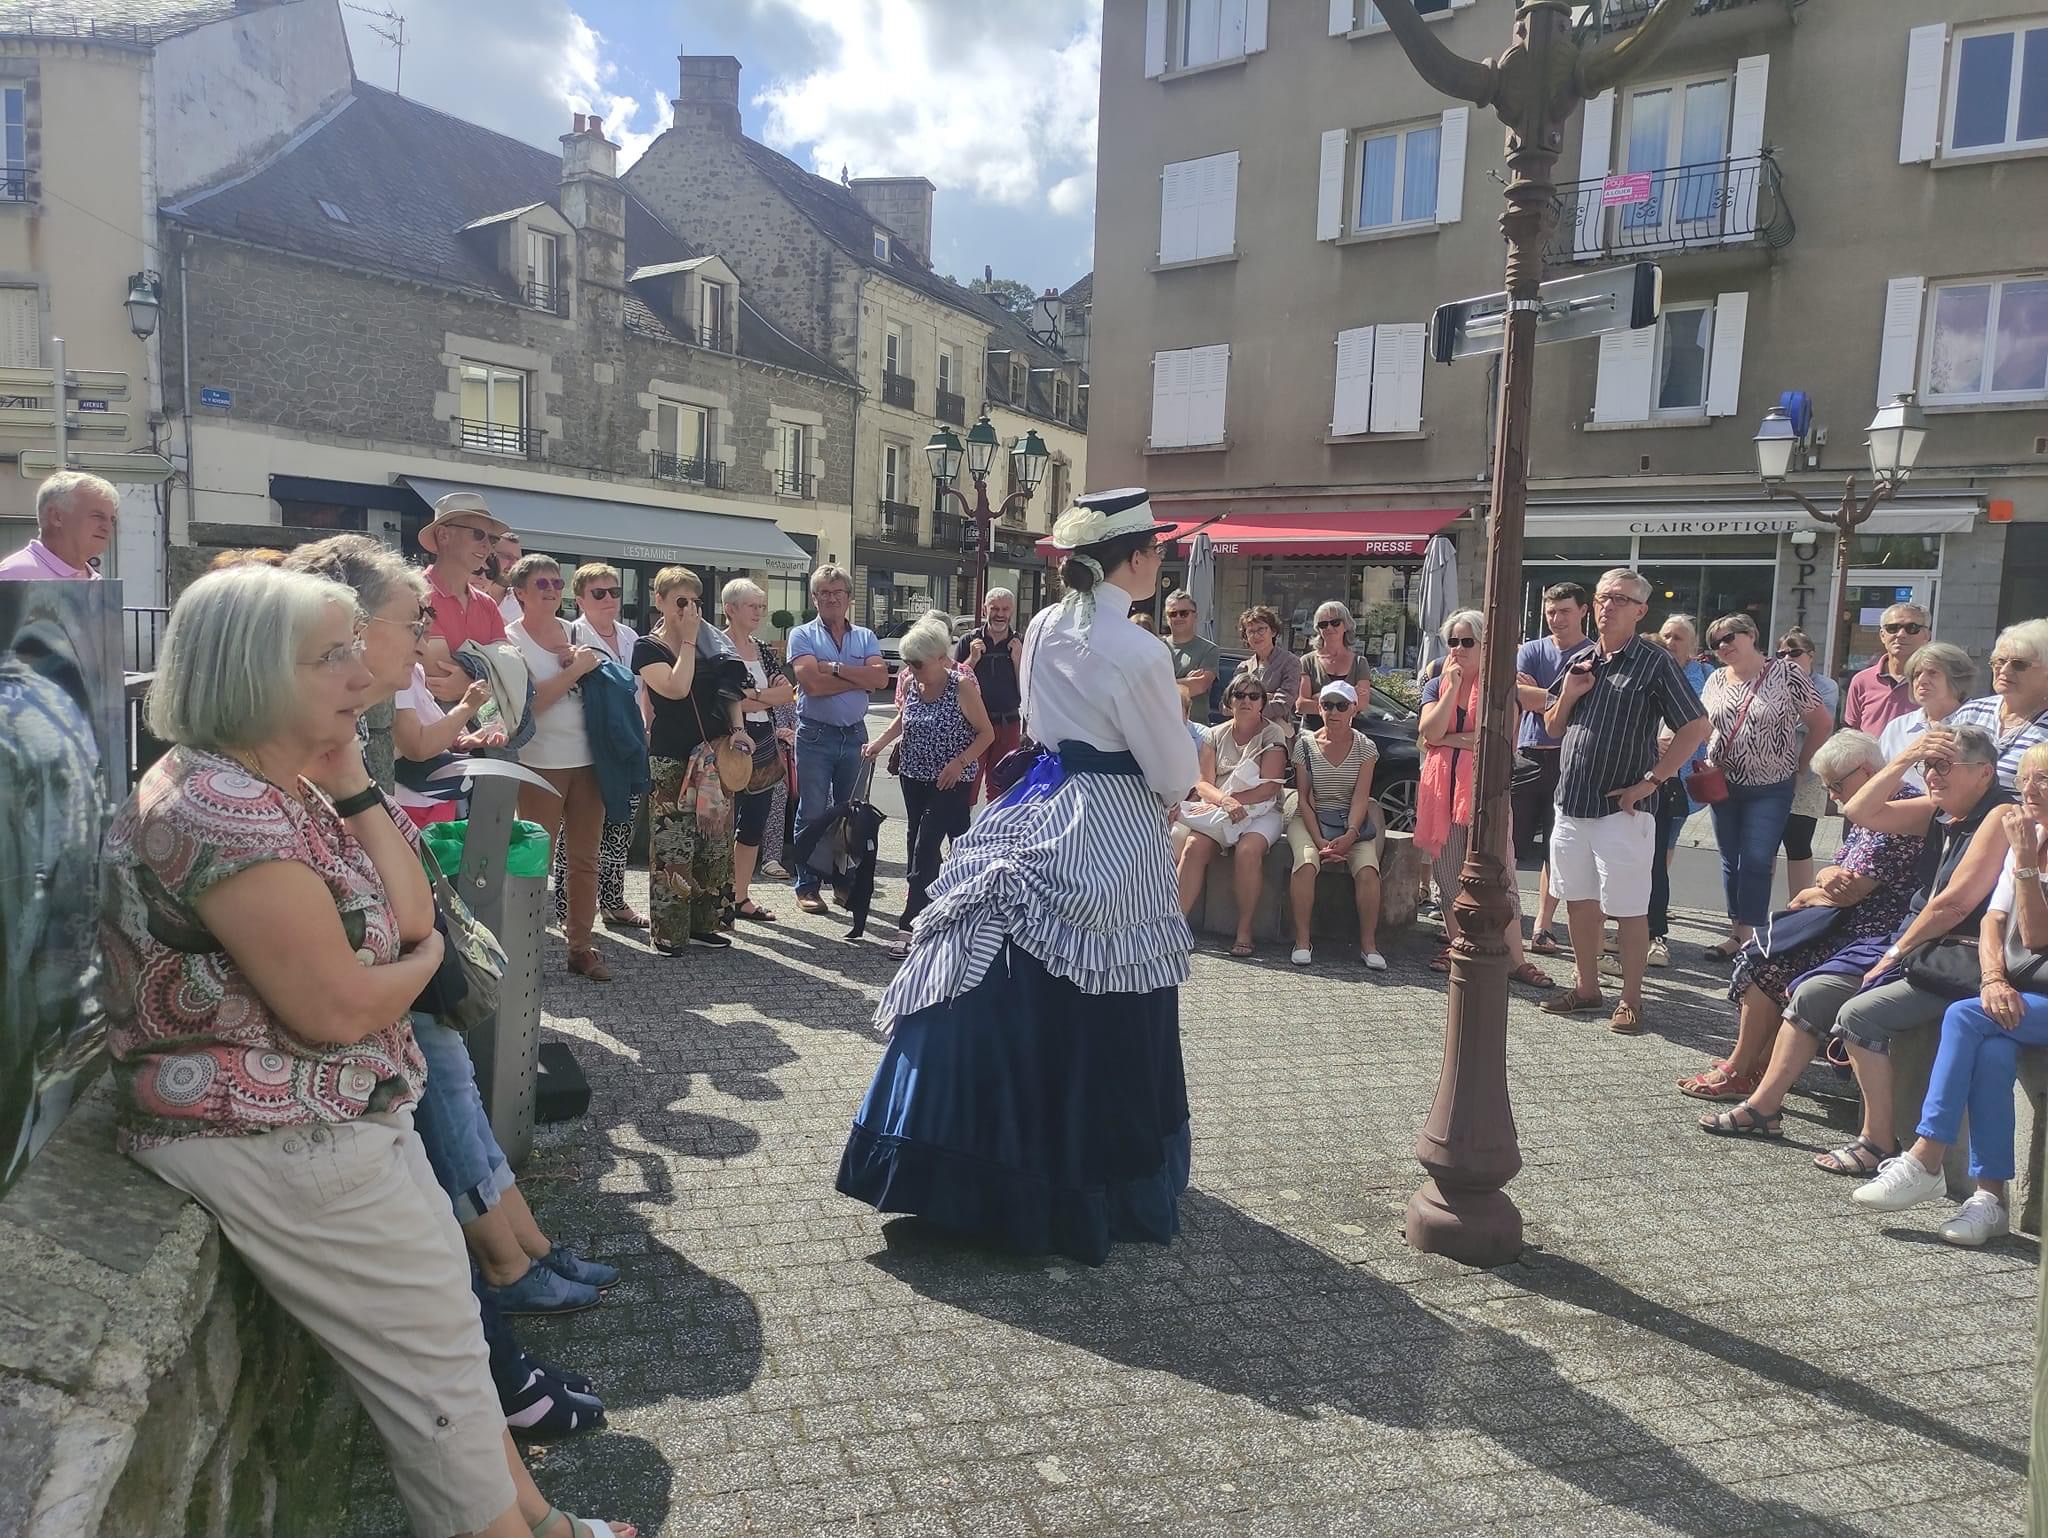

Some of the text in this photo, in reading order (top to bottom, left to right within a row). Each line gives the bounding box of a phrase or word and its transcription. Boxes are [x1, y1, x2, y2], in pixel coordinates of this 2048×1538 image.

[83, 401, 105, 409] AVENUE
[1629, 520, 1798, 534] CLAIR'OPTIQUE
[622, 543, 678, 561] L'ESTAMINET
[1366, 541, 1413, 552] PRESSE
[765, 558, 805, 570] Restaurant
